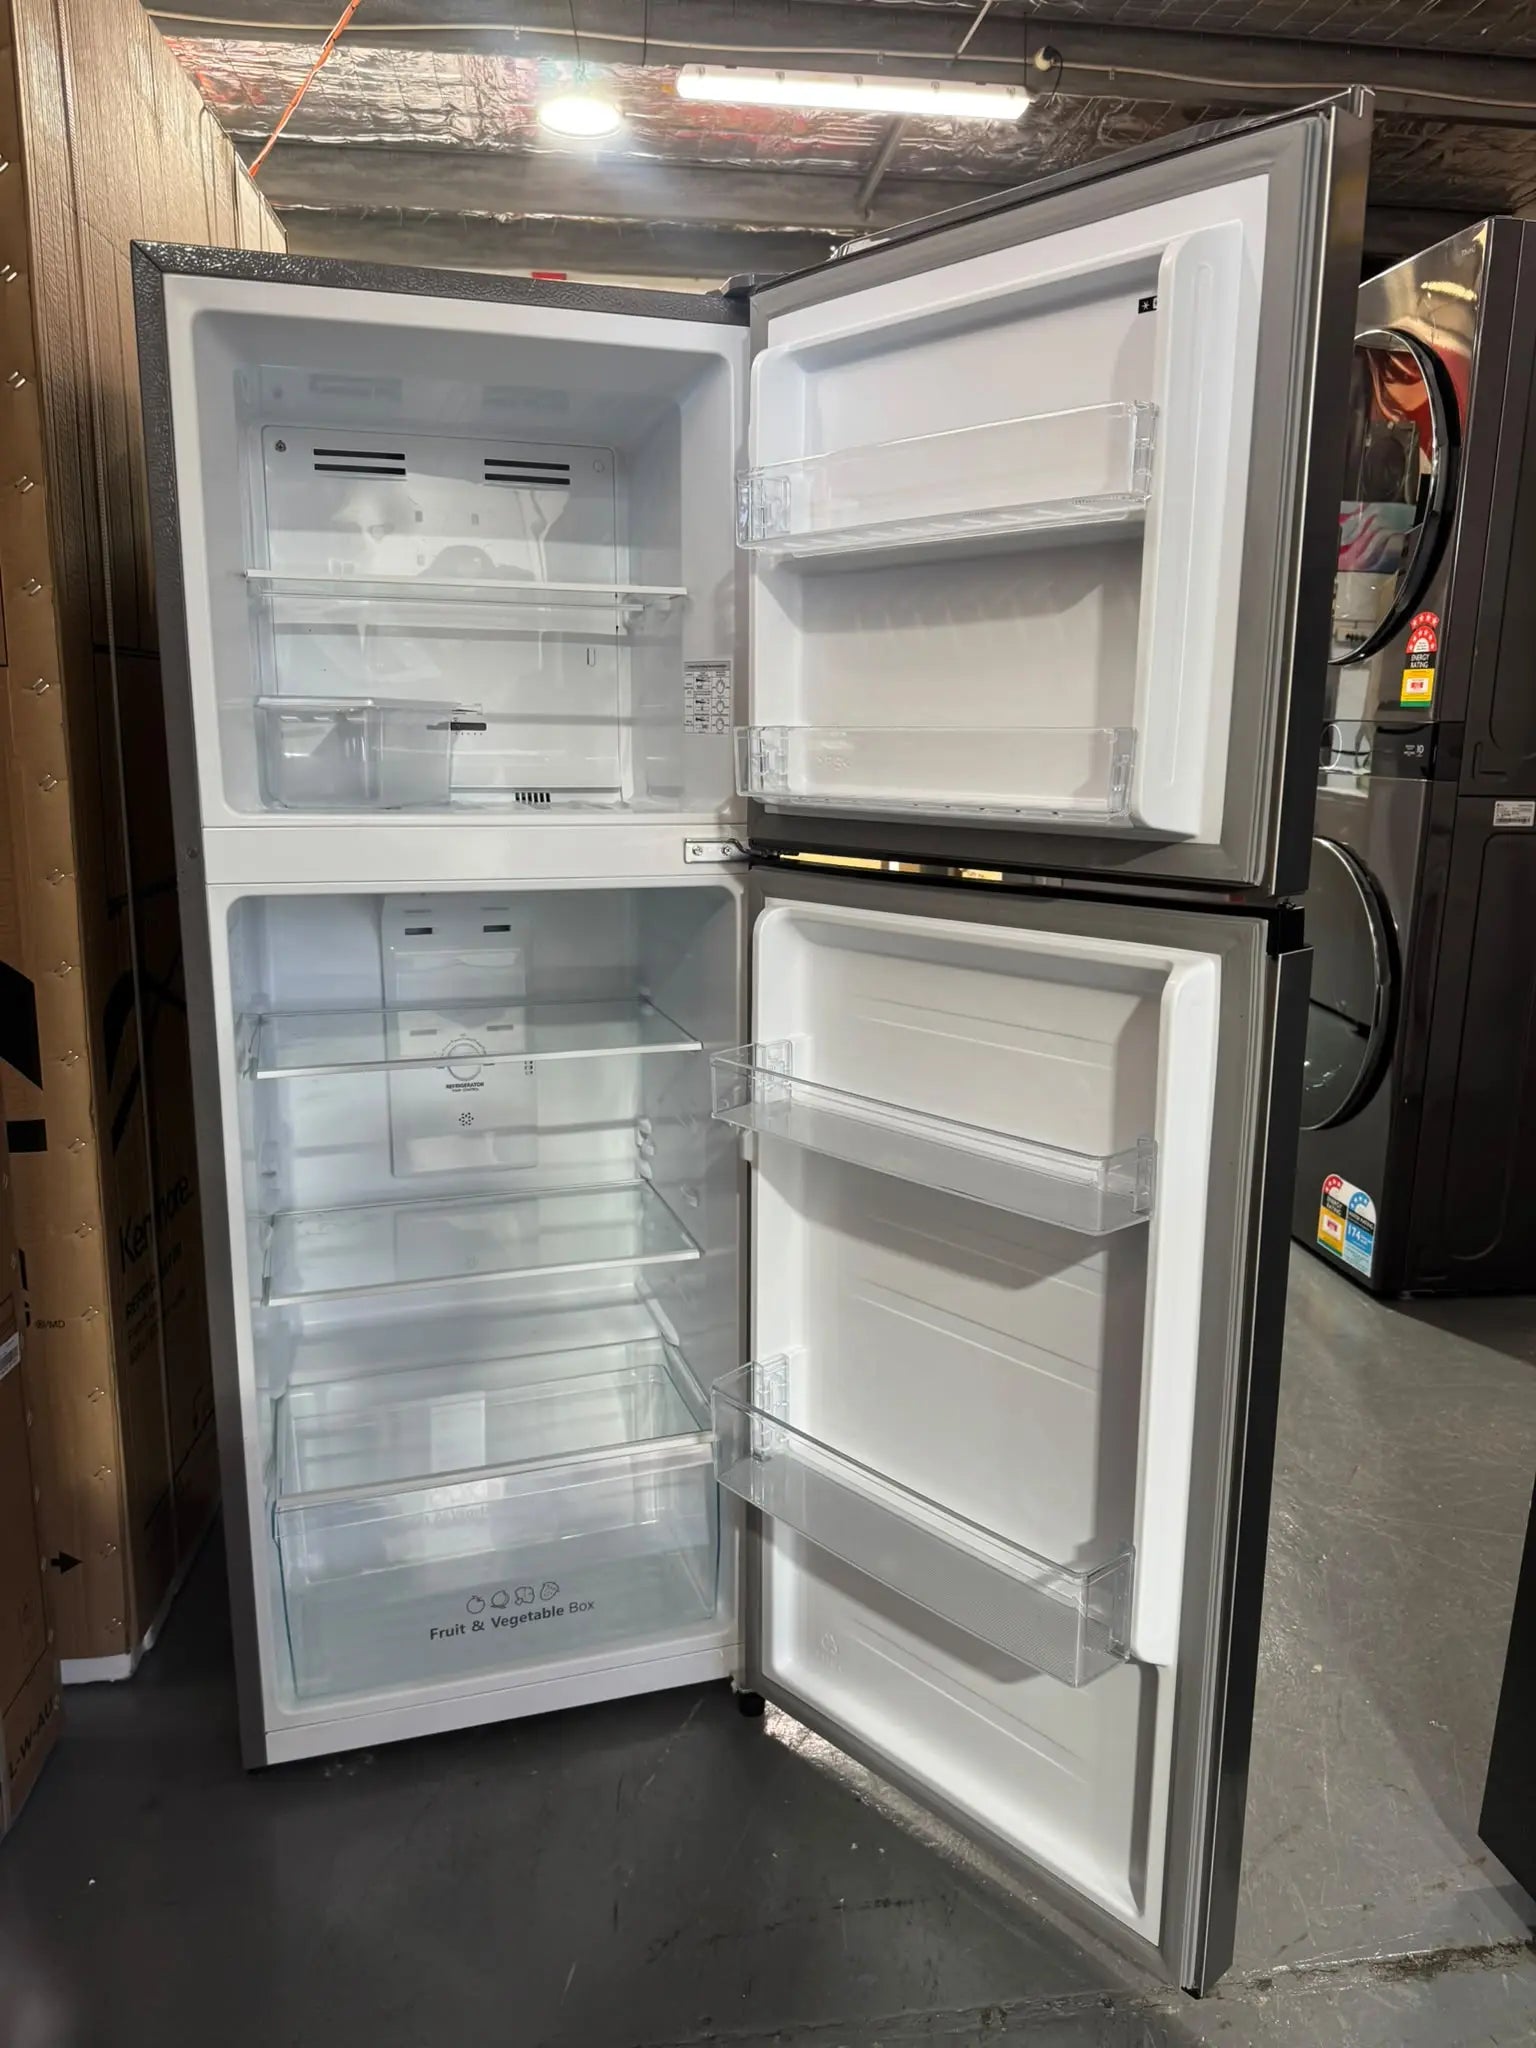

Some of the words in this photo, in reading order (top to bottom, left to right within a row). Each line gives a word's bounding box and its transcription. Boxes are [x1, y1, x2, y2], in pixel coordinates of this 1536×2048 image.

[445, 1082, 484, 1090] REFRIGERATOR
[430, 1622, 466, 1640] Fruit
[471, 1619, 485, 1632] &
[491, 1605, 565, 1629] Vegetable
[569, 1600, 596, 1614] Box
